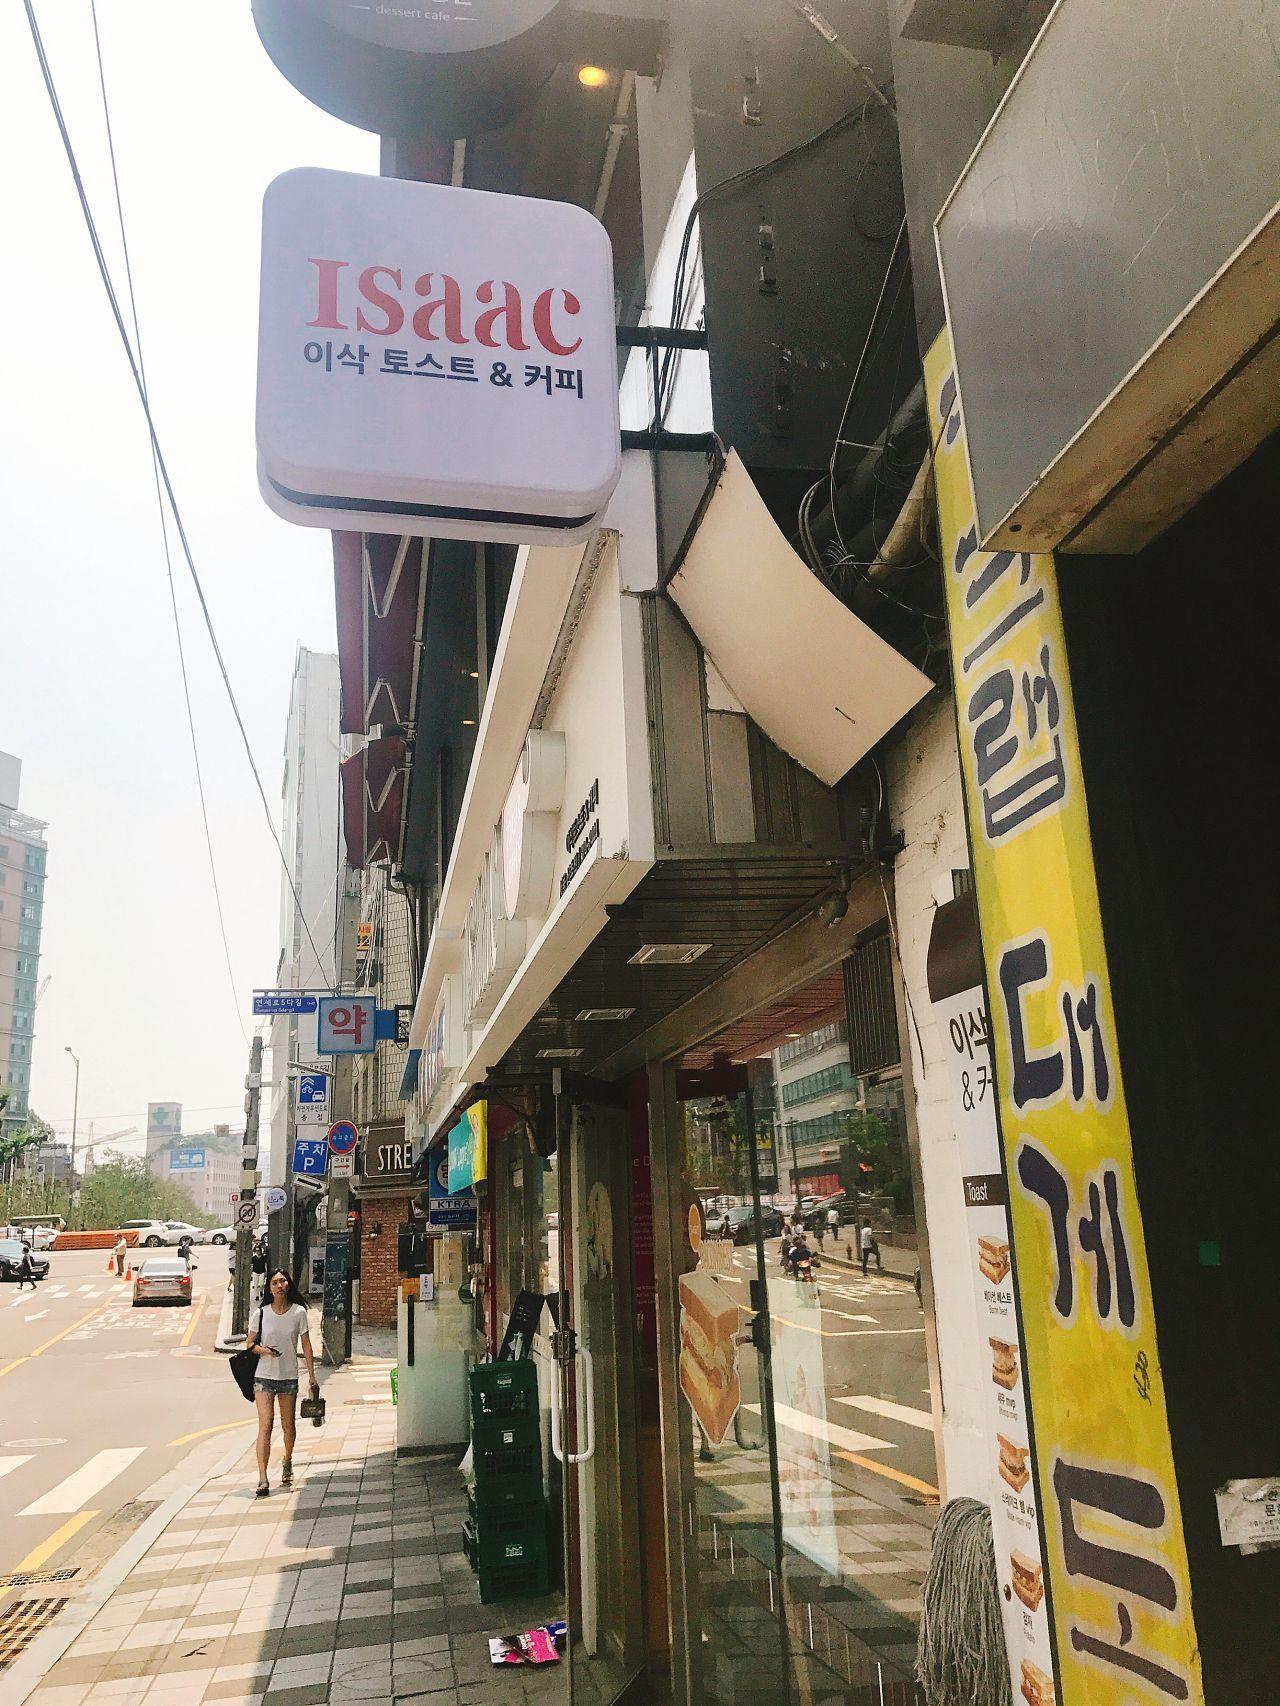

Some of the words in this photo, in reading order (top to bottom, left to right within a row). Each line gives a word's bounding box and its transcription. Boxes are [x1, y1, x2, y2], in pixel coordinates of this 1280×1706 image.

[375, 5, 421, 18] dessert
[424, 12, 450, 22] cafe
[305, 257, 583, 356] Isaac
[303, 341, 370, 375] 이삭
[379, 348, 479, 383] 토스트
[489, 361, 515, 388] &
[524, 365, 584, 399] 커피
[328, 1005, 367, 1045] 약
[303, 1157, 314, 1171] P
[378, 1142, 412, 1171] STRE
[967, 1182, 988, 1201] Toast
[242, 1209, 253, 1218] 30
[437, 1200, 471, 1209] KTRA
